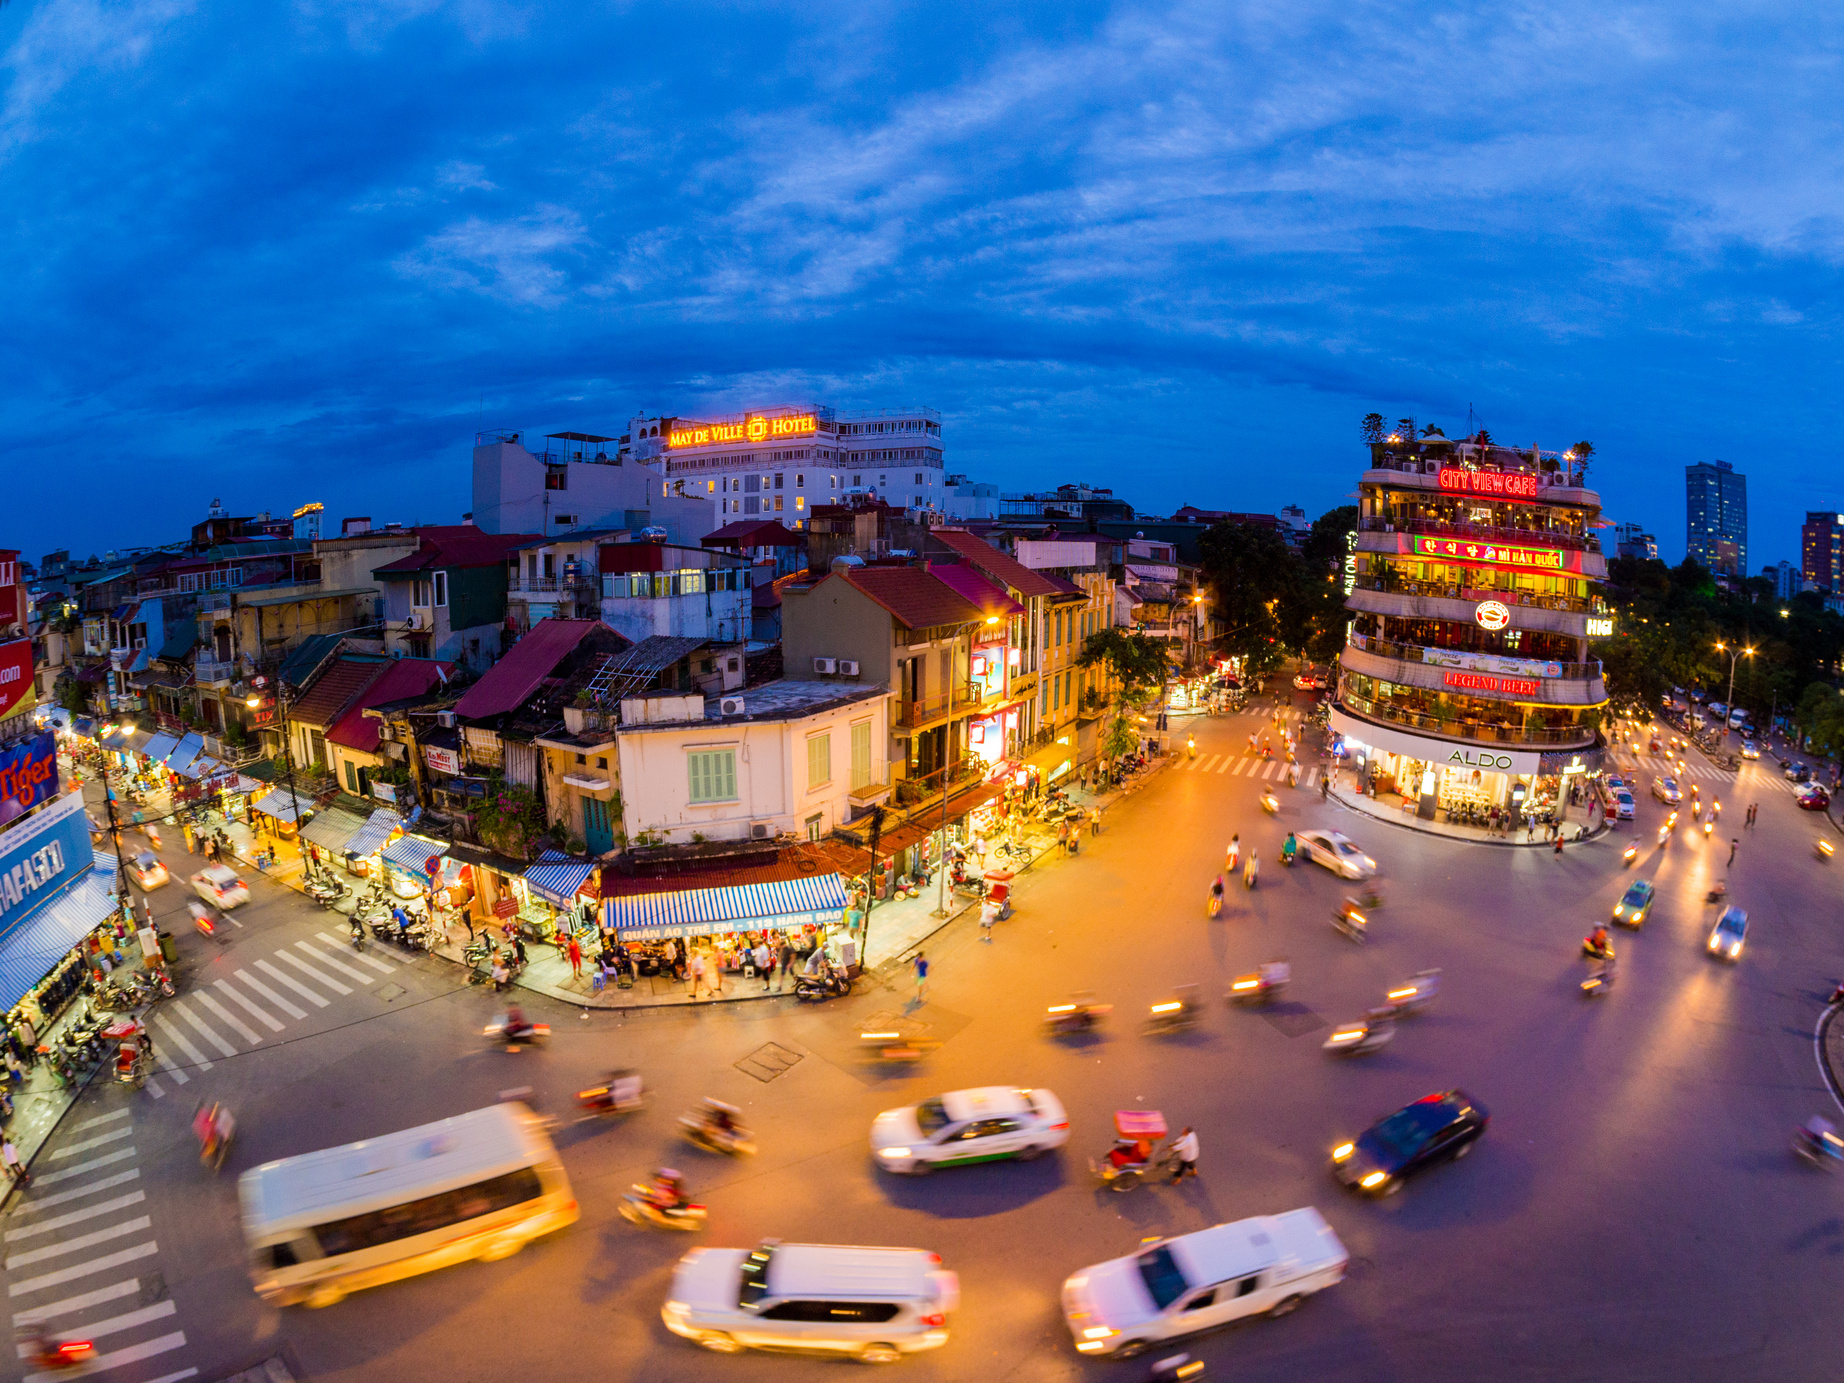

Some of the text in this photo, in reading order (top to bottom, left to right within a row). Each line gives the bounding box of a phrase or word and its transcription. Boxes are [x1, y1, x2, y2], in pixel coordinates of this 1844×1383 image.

[669, 417, 816, 447] MAY DE VILLE HOTEL
[1439, 469, 1536, 496] CITY VIEW CAFE
[1498, 548, 1559, 567] MÌ HÀN QUỐC
[1445, 672, 1536, 696] LEGEND BEER
[1449, 750, 1512, 769] ALDO
[713, 922, 734, 932] EM
